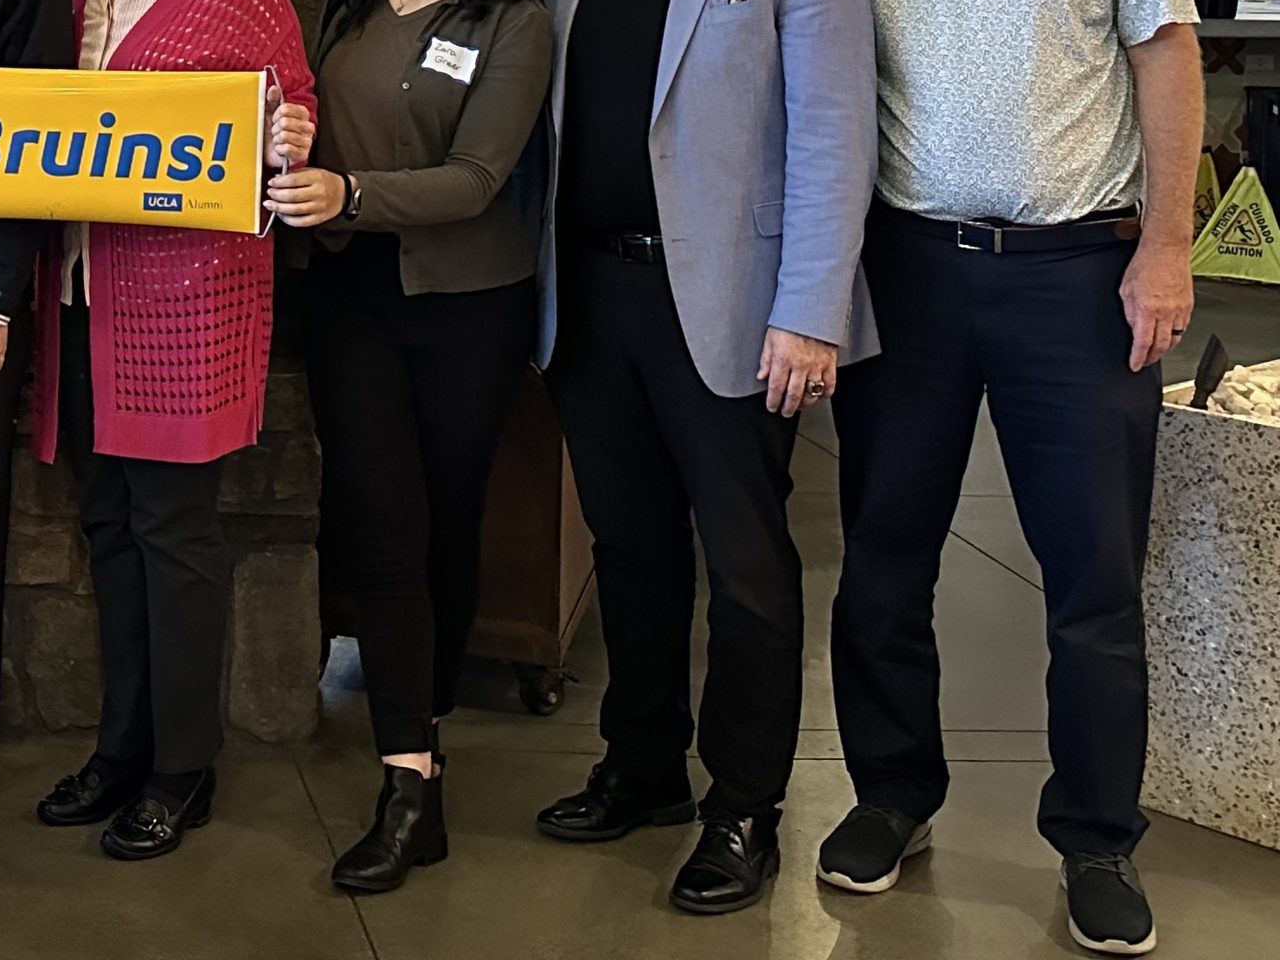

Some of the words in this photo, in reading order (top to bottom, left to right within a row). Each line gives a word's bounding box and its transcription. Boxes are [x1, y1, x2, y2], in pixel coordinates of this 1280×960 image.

[435, 43, 457, 57] Zara
[148, 196, 178, 208] UCLA
[186, 199, 223, 210] Alumni
[1211, 203, 1240, 238] ATTENTION
[1249, 202, 1275, 244] CUIDADO
[1217, 245, 1263, 258] CAUTION
